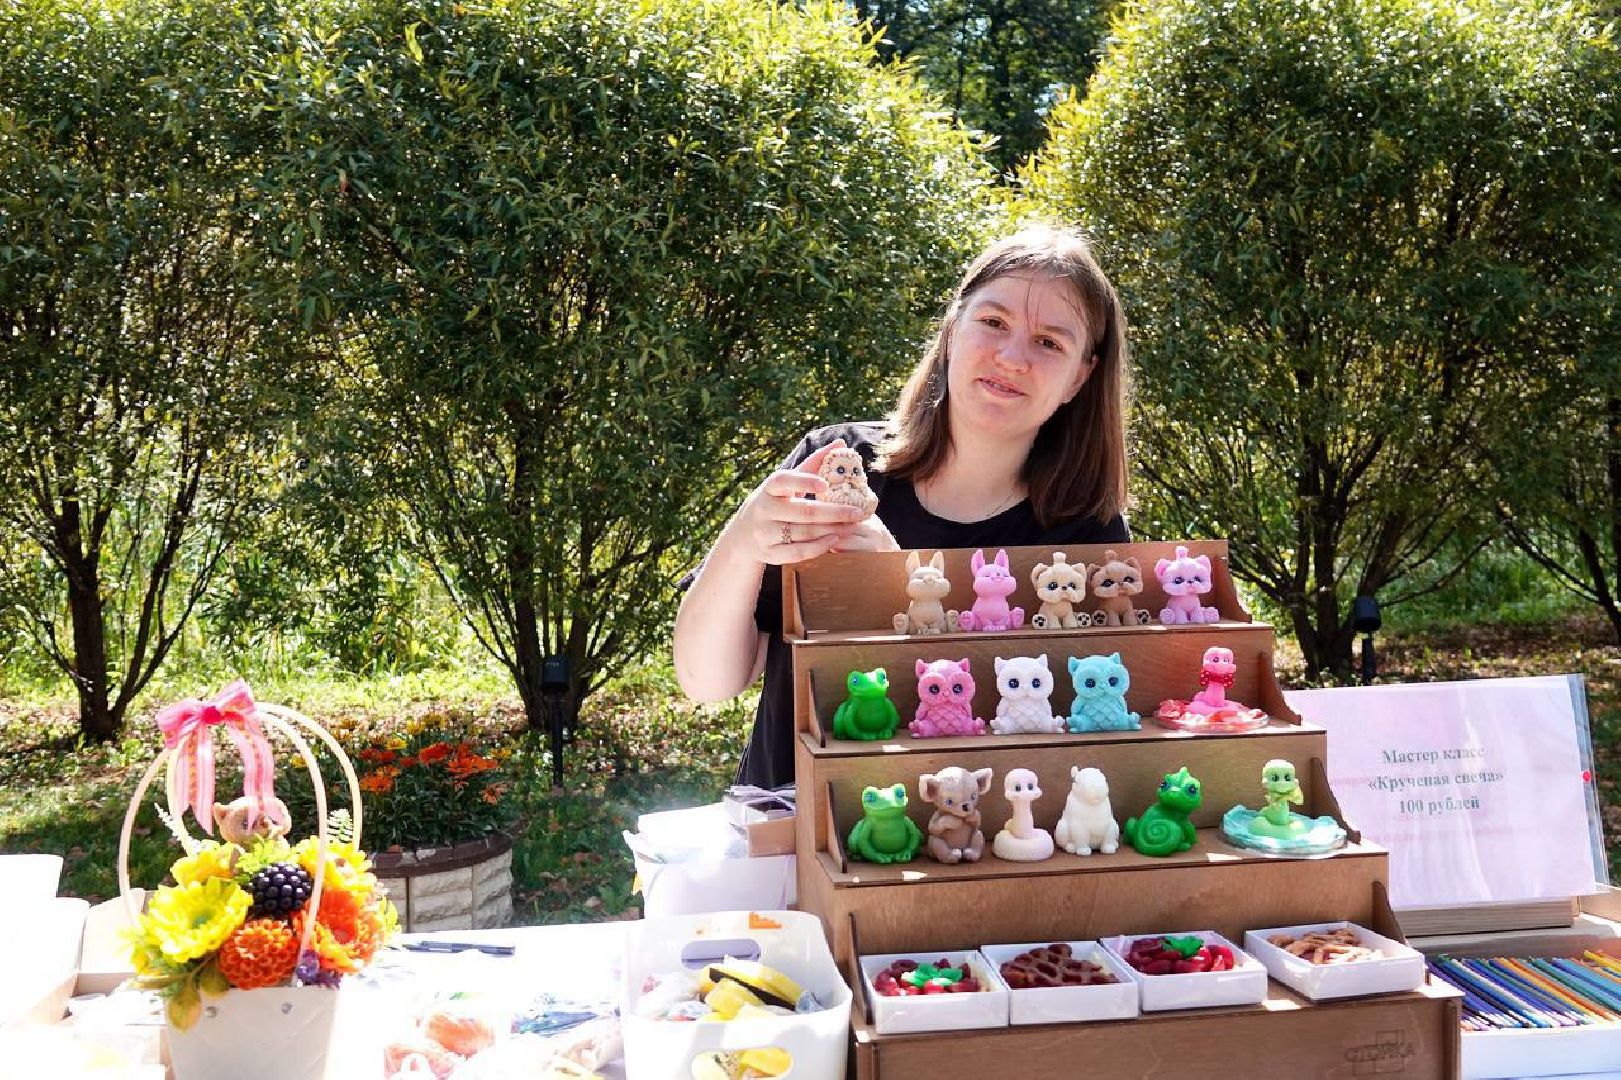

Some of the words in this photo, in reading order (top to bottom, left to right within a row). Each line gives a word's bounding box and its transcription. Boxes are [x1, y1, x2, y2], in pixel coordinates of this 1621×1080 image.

[1382, 749, 1438, 764] Мастер
[1443, 748, 1488, 760] класс
[1400, 799, 1424, 815] 100
[1428, 796, 1480, 815] рублей
